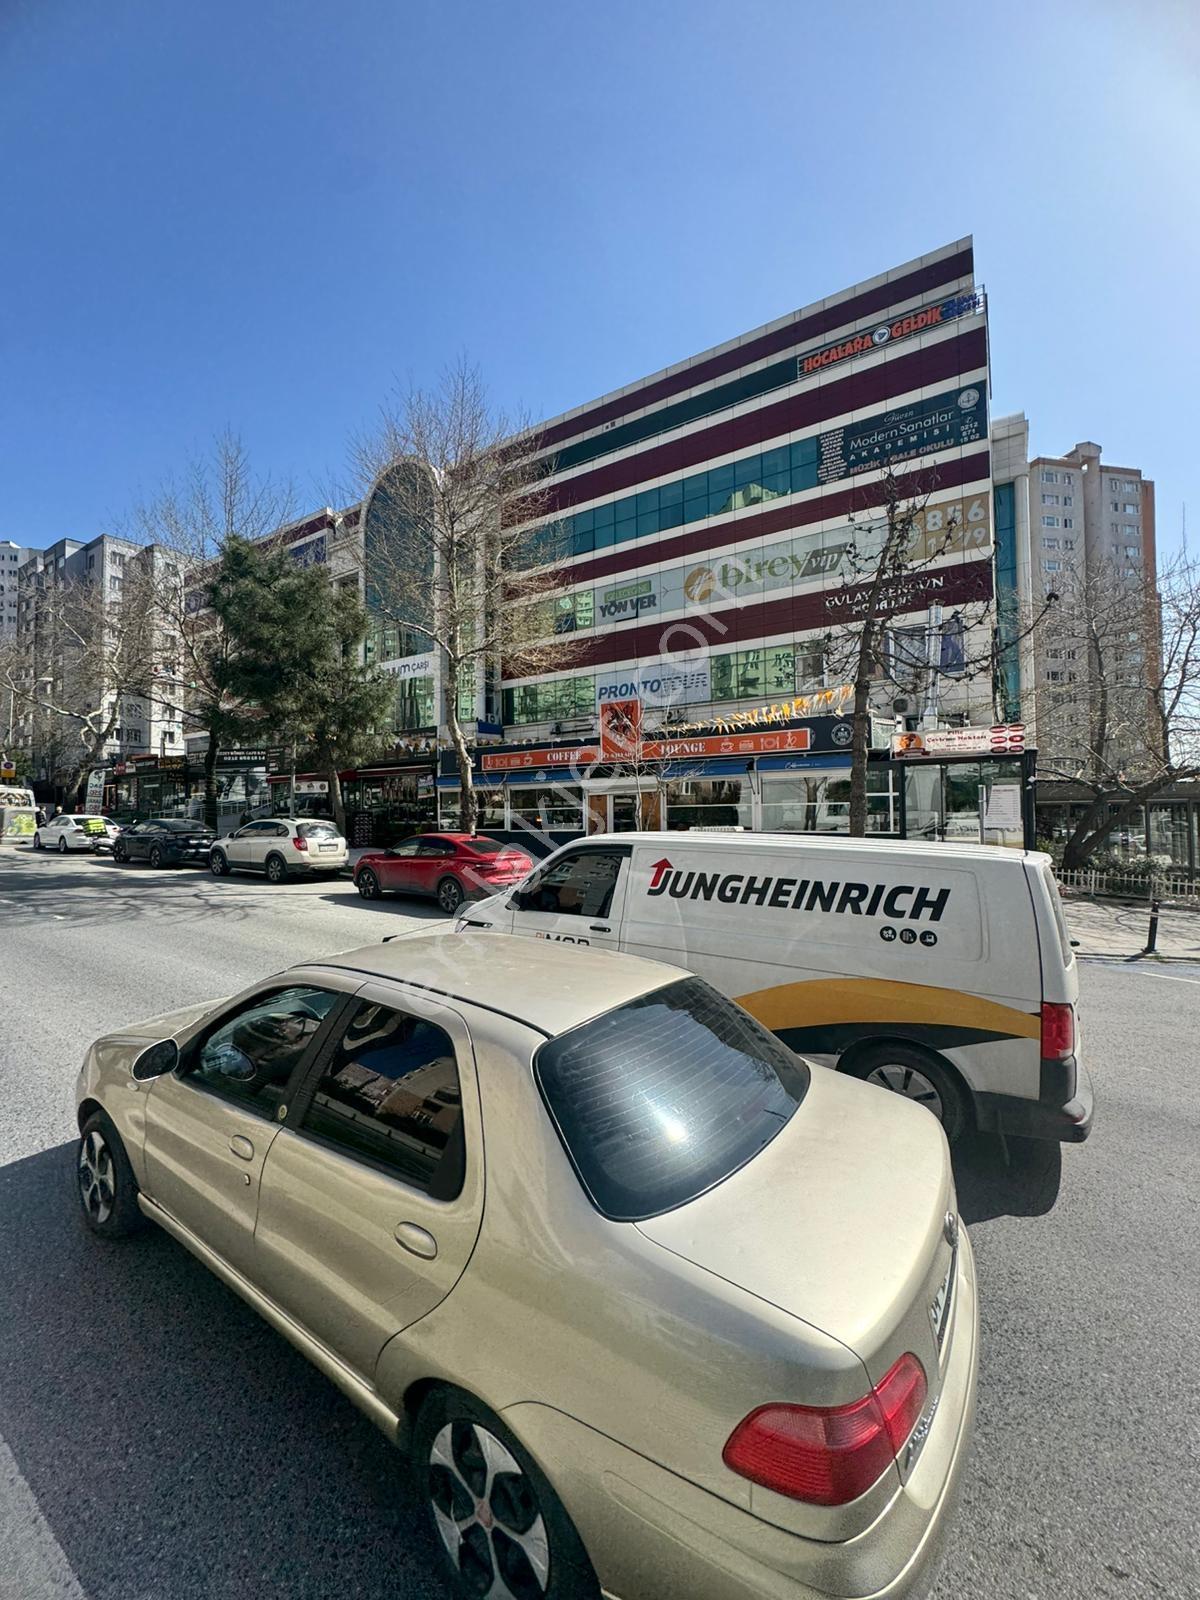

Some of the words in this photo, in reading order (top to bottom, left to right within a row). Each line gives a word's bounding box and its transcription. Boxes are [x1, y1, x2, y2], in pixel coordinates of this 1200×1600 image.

[803, 334, 873, 372] HOCALARA
[890, 305, 942, 337] GELDİK
[850, 427, 898, 450] Modern
[900, 410, 954, 435] Sanatlar
[919, 438, 955, 453] OKULU
[721, 551, 808, 588] birey
[810, 549, 838, 571] vip
[599, 599, 628, 618] YÖN
[630, 593, 657, 613] VER
[546, 750, 581, 762] COFFEE
[660, 742, 706, 755] LOUNGE
[647, 870, 951, 921] JUNGHEINRICH
